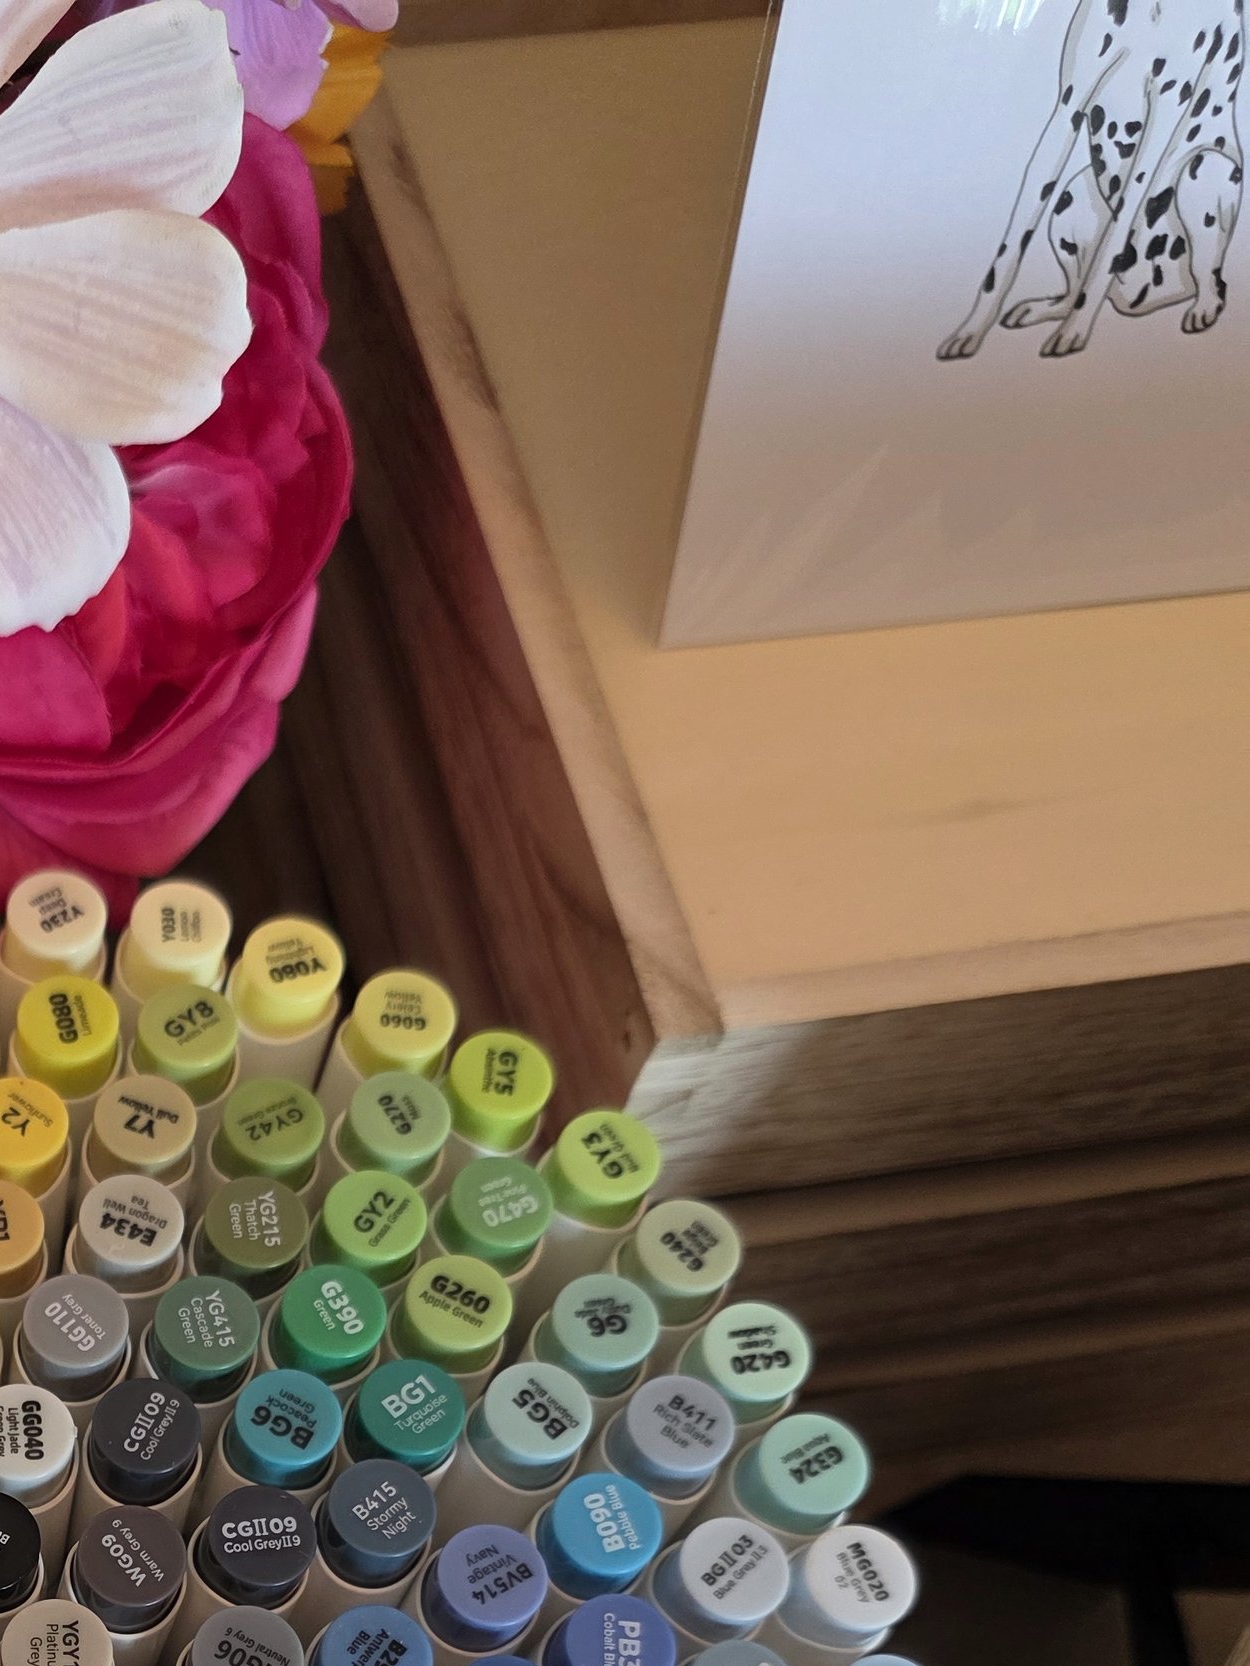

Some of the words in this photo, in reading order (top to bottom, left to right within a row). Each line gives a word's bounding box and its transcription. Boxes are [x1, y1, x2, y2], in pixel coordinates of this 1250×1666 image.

[164, 1001, 214, 1040] GY8
[354, 1190, 395, 1232] GY2
[317, 1280, 364, 1334] G390
[418, 1290, 455, 1314] Apple
[452, 1307, 483, 1328] Green
[431, 1275, 490, 1314] G260
[314, 1300, 335, 1330] Green
[381, 1375, 435, 1422] BG1
[394, 1395, 447, 1433] Turquoise
[512, 1390, 572, 1440] BG5
[668, 1395, 717, 1435] B411
[6, 1408, 19, 1431] Light
[22, 1401, 44, 1460] GG040
[412, 1410, 445, 1433] Green
[8, 1432, 19, 1455] Jade
[352, 1482, 402, 1522] B415
[366, 1496, 409, 1533] Stormy
[380, 1512, 416, 1539] Night
[27, 1637, 42, 1666] Grey
